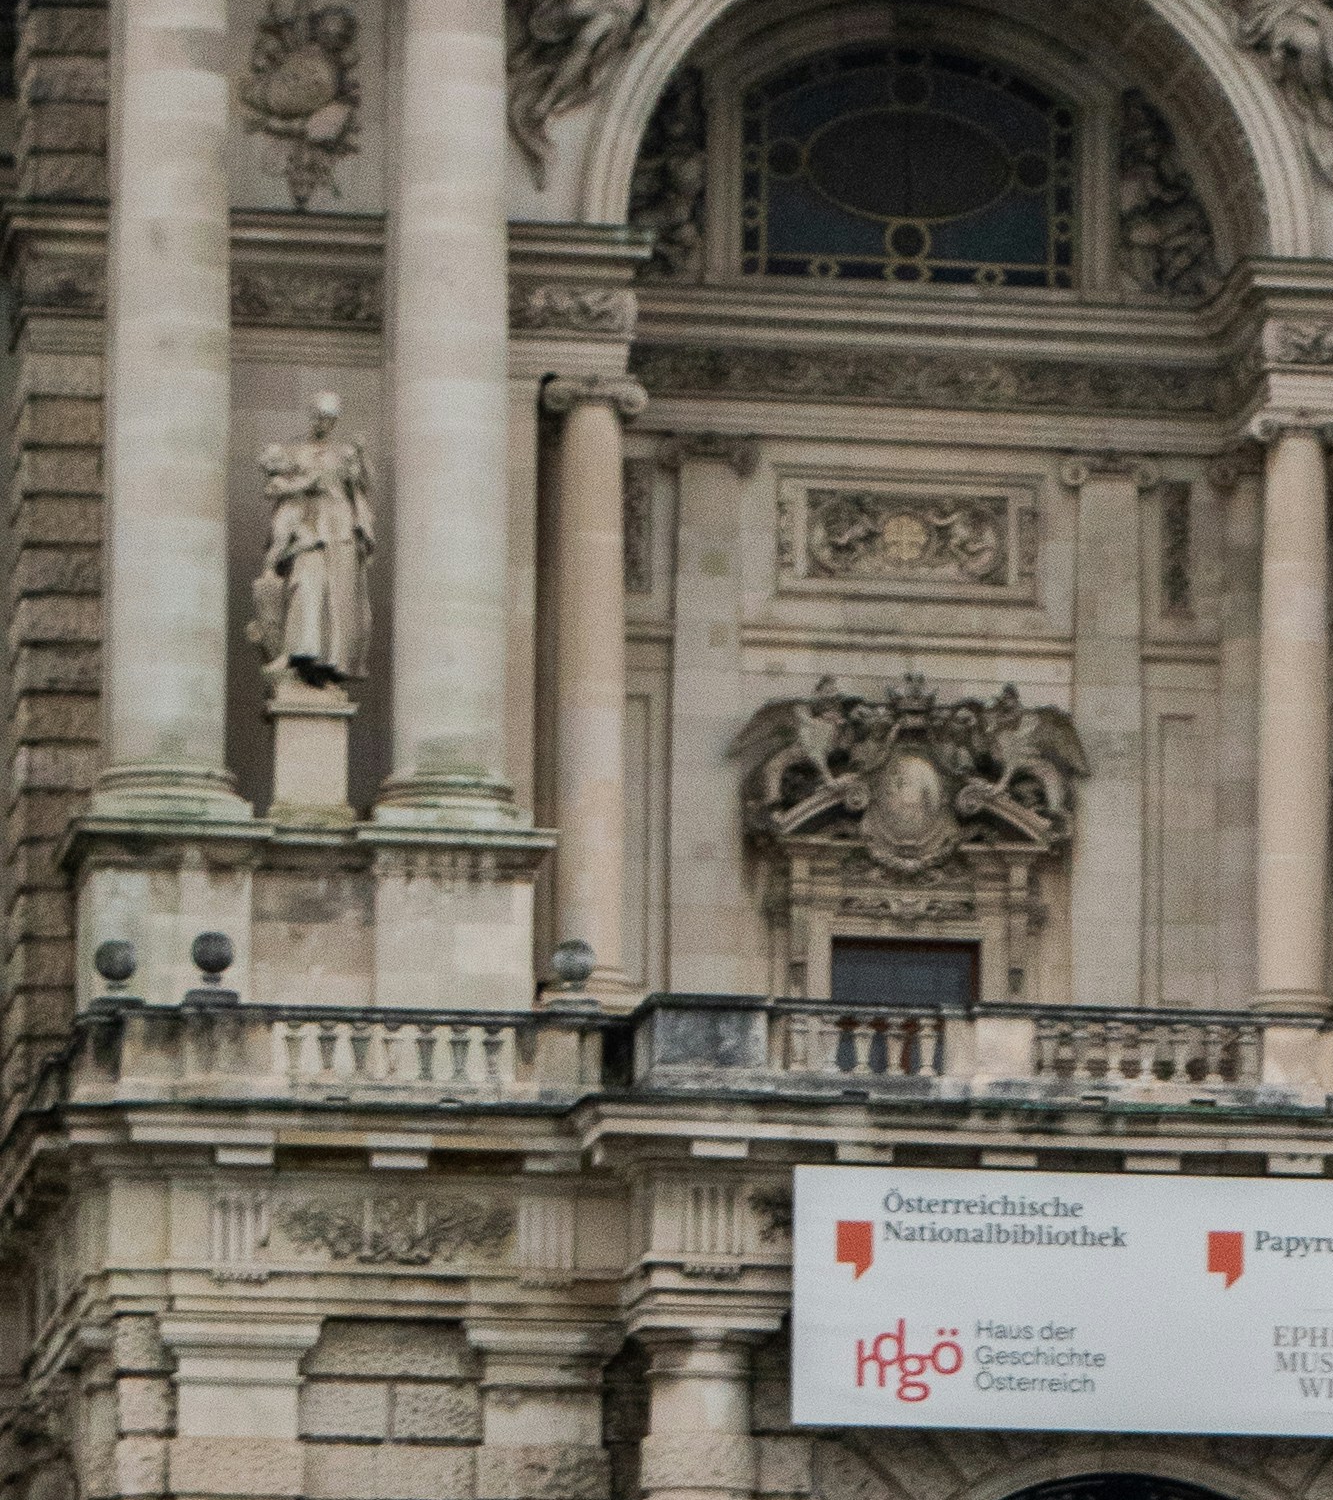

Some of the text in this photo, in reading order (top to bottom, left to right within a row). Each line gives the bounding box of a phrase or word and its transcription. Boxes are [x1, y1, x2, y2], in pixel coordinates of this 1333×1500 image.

[883, 1189, 1084, 1219] Österreichische
[883, 1220, 1127, 1248] Nationalbibliothek
[975, 1321, 1077, 1341] Haus der
[975, 1345, 1107, 1369] Geschichte
[975, 1369, 1096, 1395] Österreich
